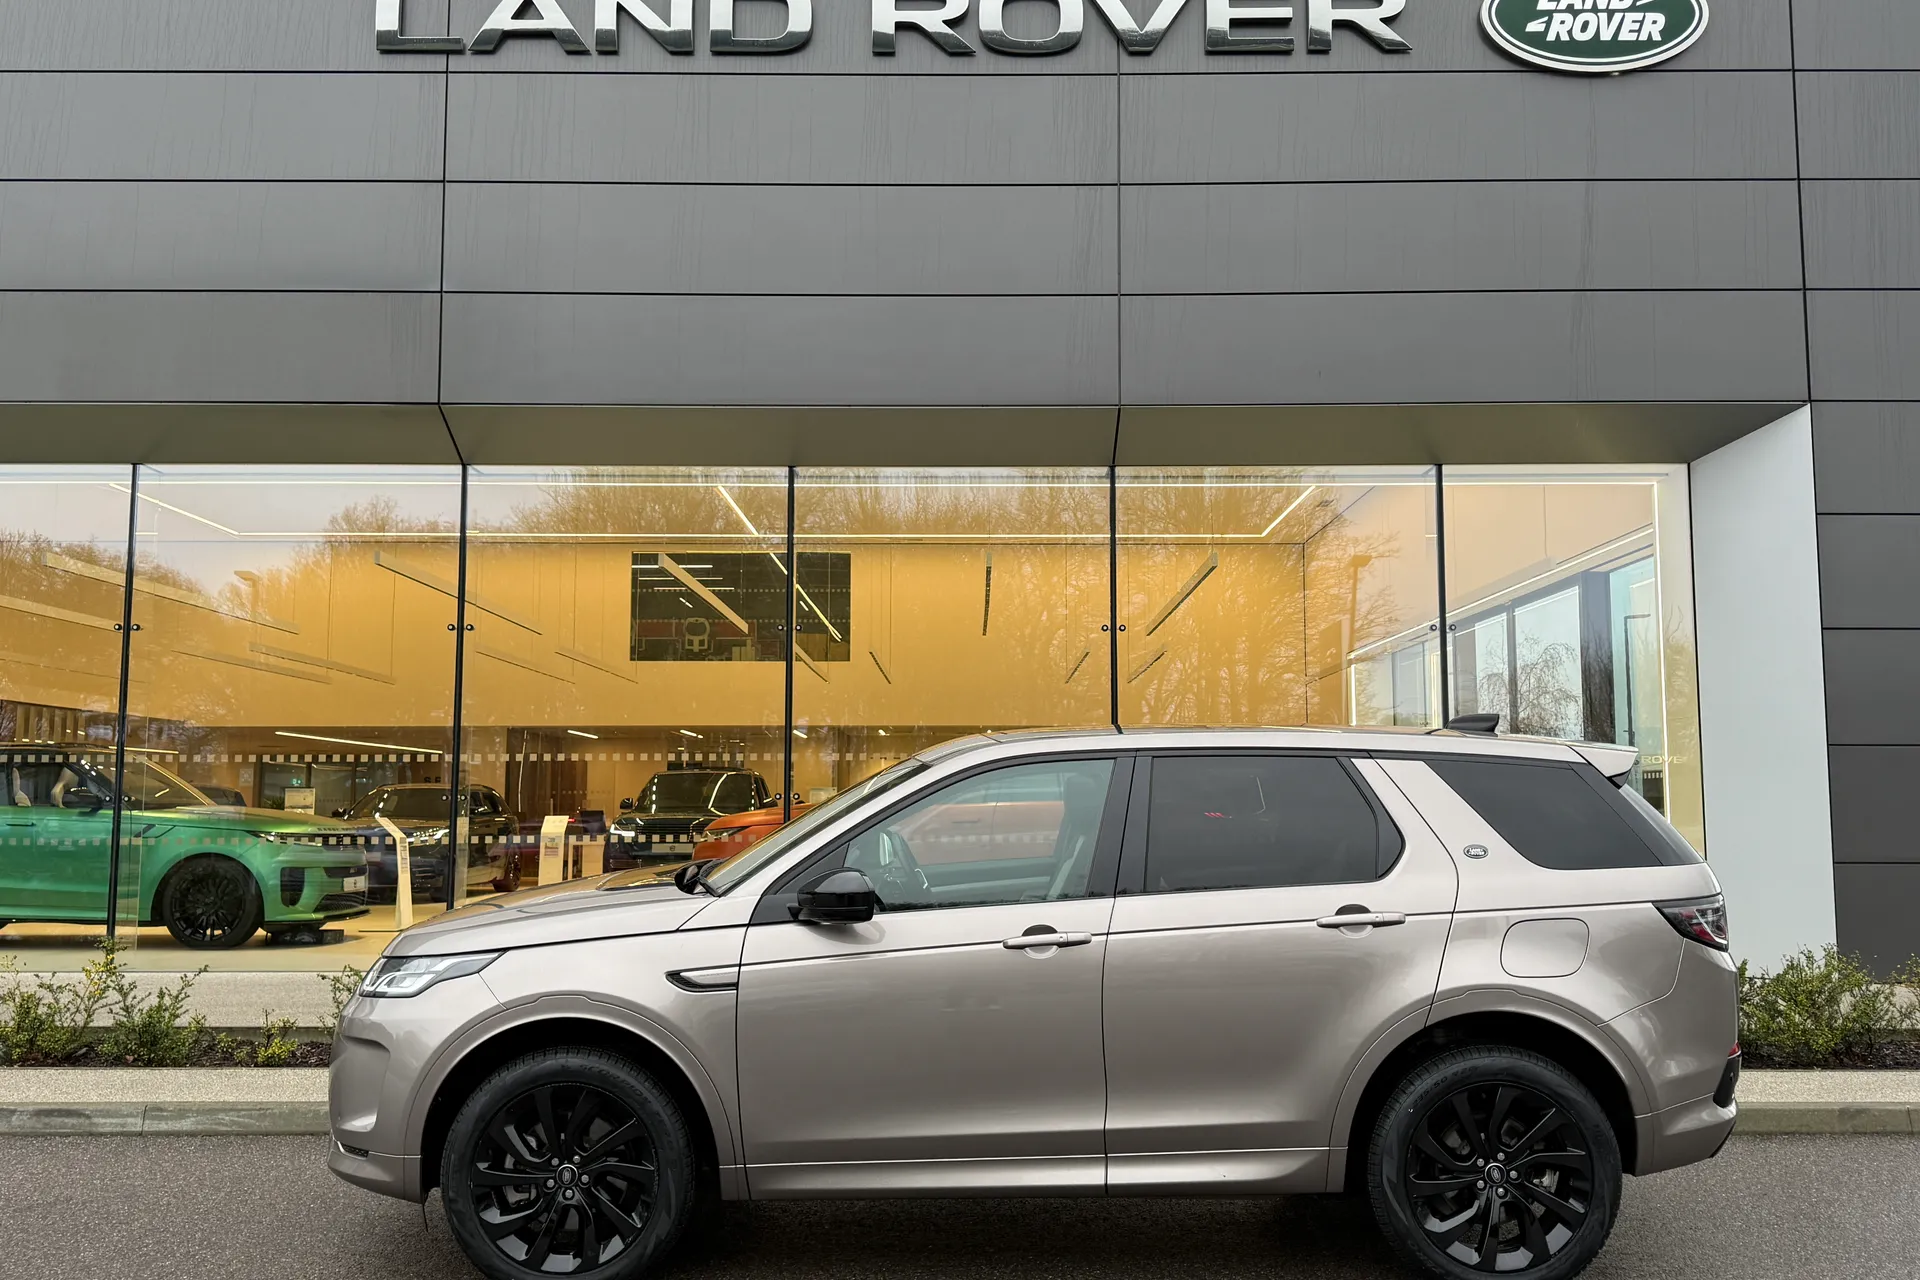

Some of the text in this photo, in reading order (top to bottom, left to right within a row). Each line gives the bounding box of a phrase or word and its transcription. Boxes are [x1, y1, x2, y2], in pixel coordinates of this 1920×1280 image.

[376, 0, 1413, 54] LAND ROVER
[1546, 12, 1666, 42] ROVER
